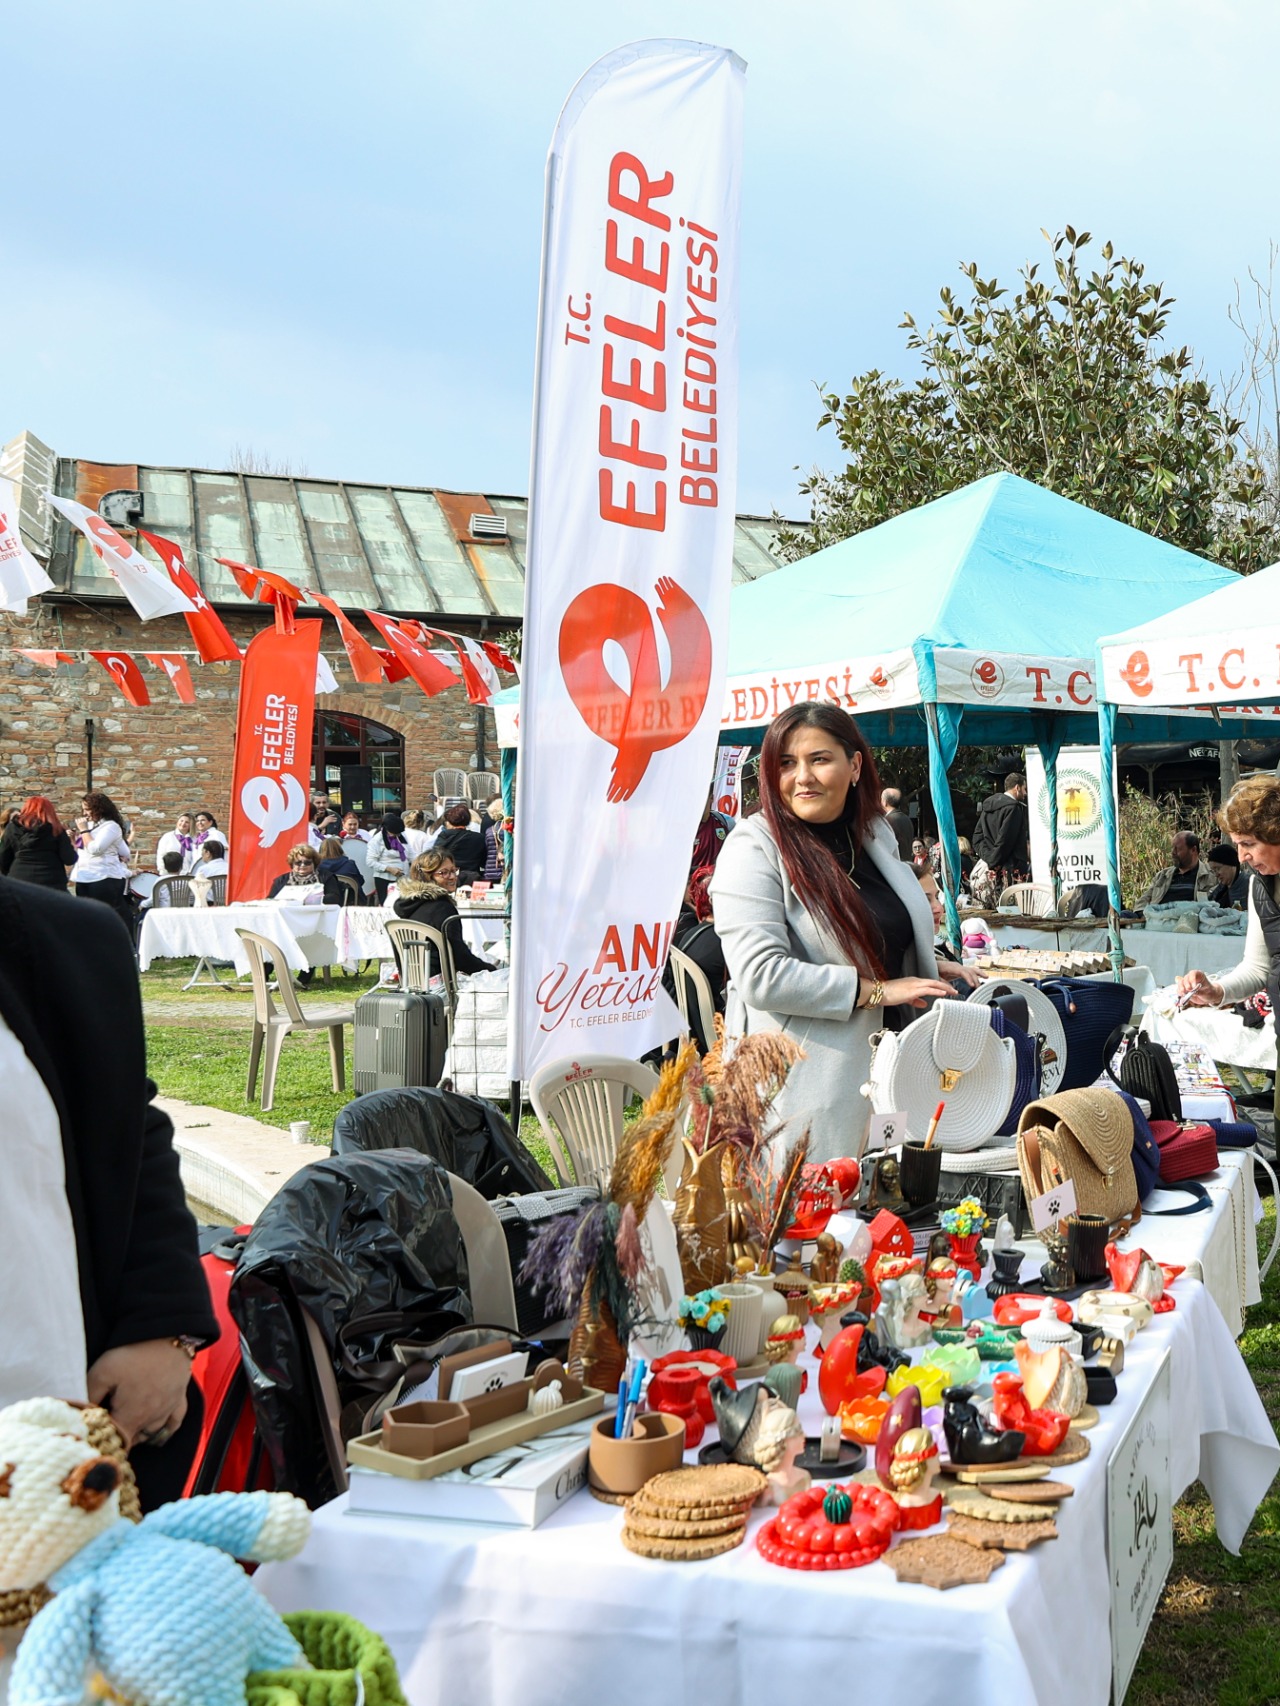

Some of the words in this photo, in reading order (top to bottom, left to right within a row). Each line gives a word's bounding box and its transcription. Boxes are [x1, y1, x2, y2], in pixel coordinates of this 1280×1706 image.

[565, 292, 592, 346] T.C.
[598, 151, 674, 532] EFELER
[676, 216, 719, 508] BELEDİYESİ
[1178, 648, 1260, 693] T.C.
[262, 694, 286, 771] EFELER
[284, 704, 298, 765] BELEDİYESİ
[587, 1013, 619, 1026] EFELER
